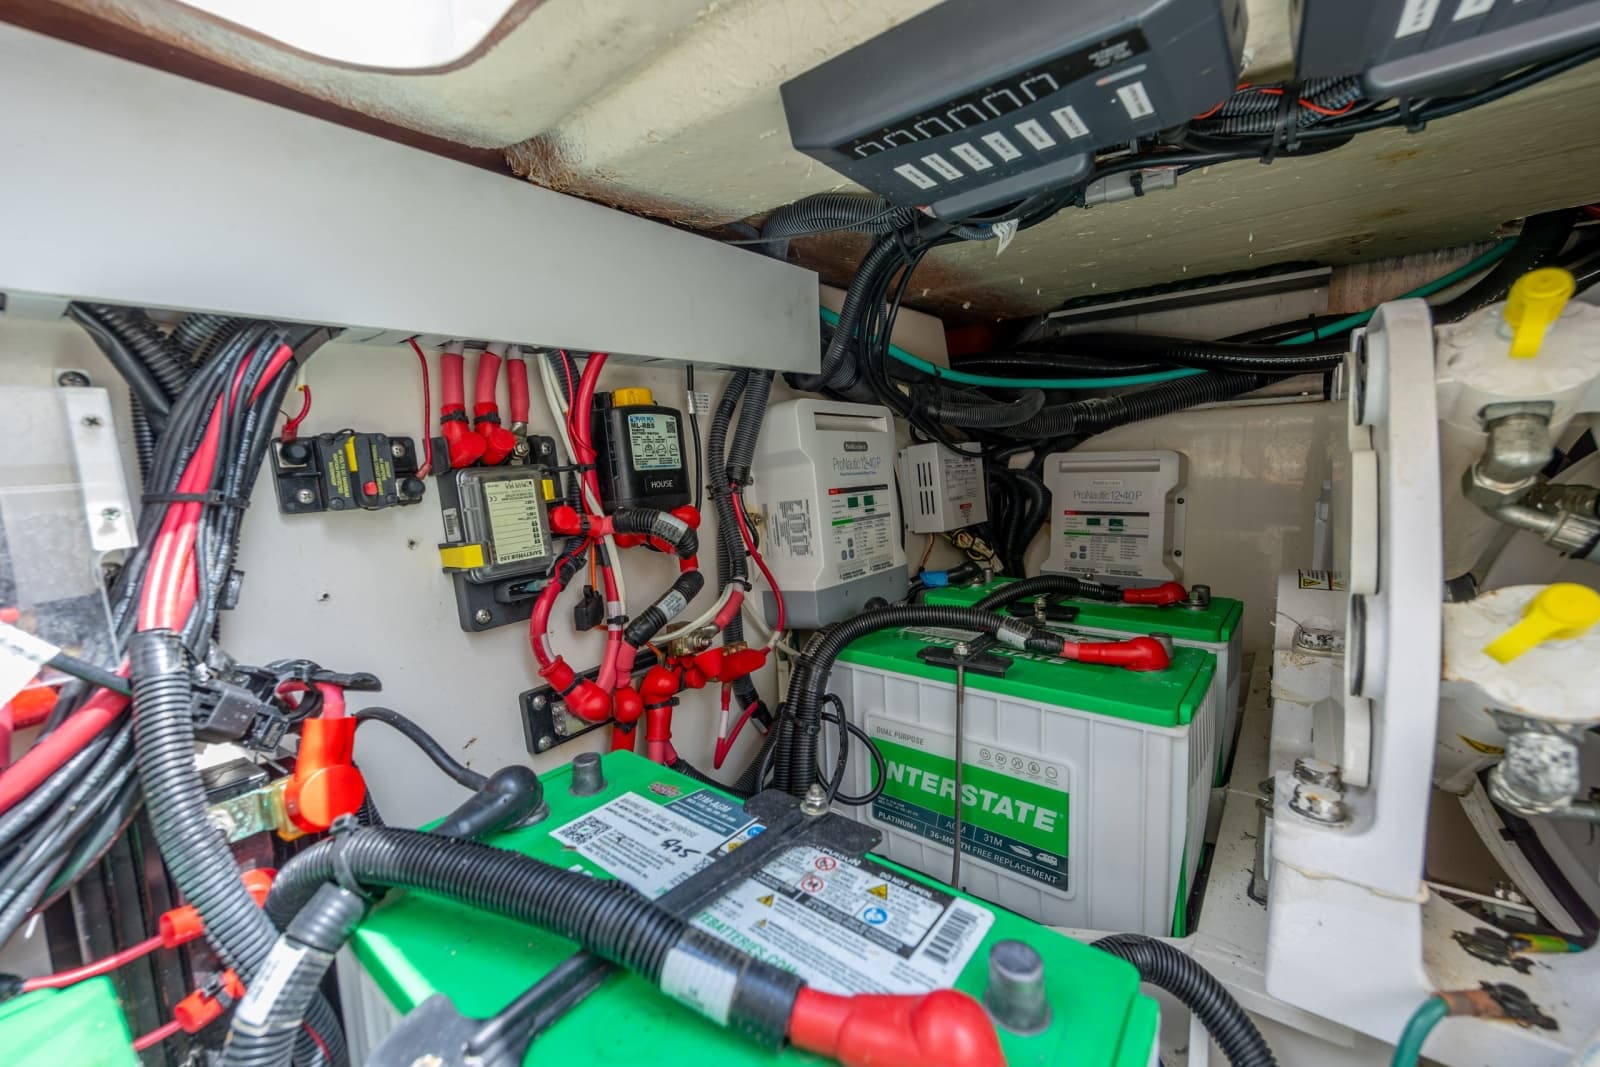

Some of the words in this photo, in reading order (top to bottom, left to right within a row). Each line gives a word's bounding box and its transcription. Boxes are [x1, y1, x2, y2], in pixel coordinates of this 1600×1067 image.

[651, 479, 673, 488] HOUSE
[876, 726, 893, 739] DUAL
[893, 731, 924, 746] PURPOSE
[884, 759, 1057, 833] NTERSTATE
[878, 811, 917, 830] PLATINUM+
[983, 832, 1003, 848] 31M
[972, 845, 992, 861] FREE
[994, 853, 1059, 885] REPLACEMENT
[892, 875, 910, 889] NOT
[909, 884, 933, 899] OPEN
